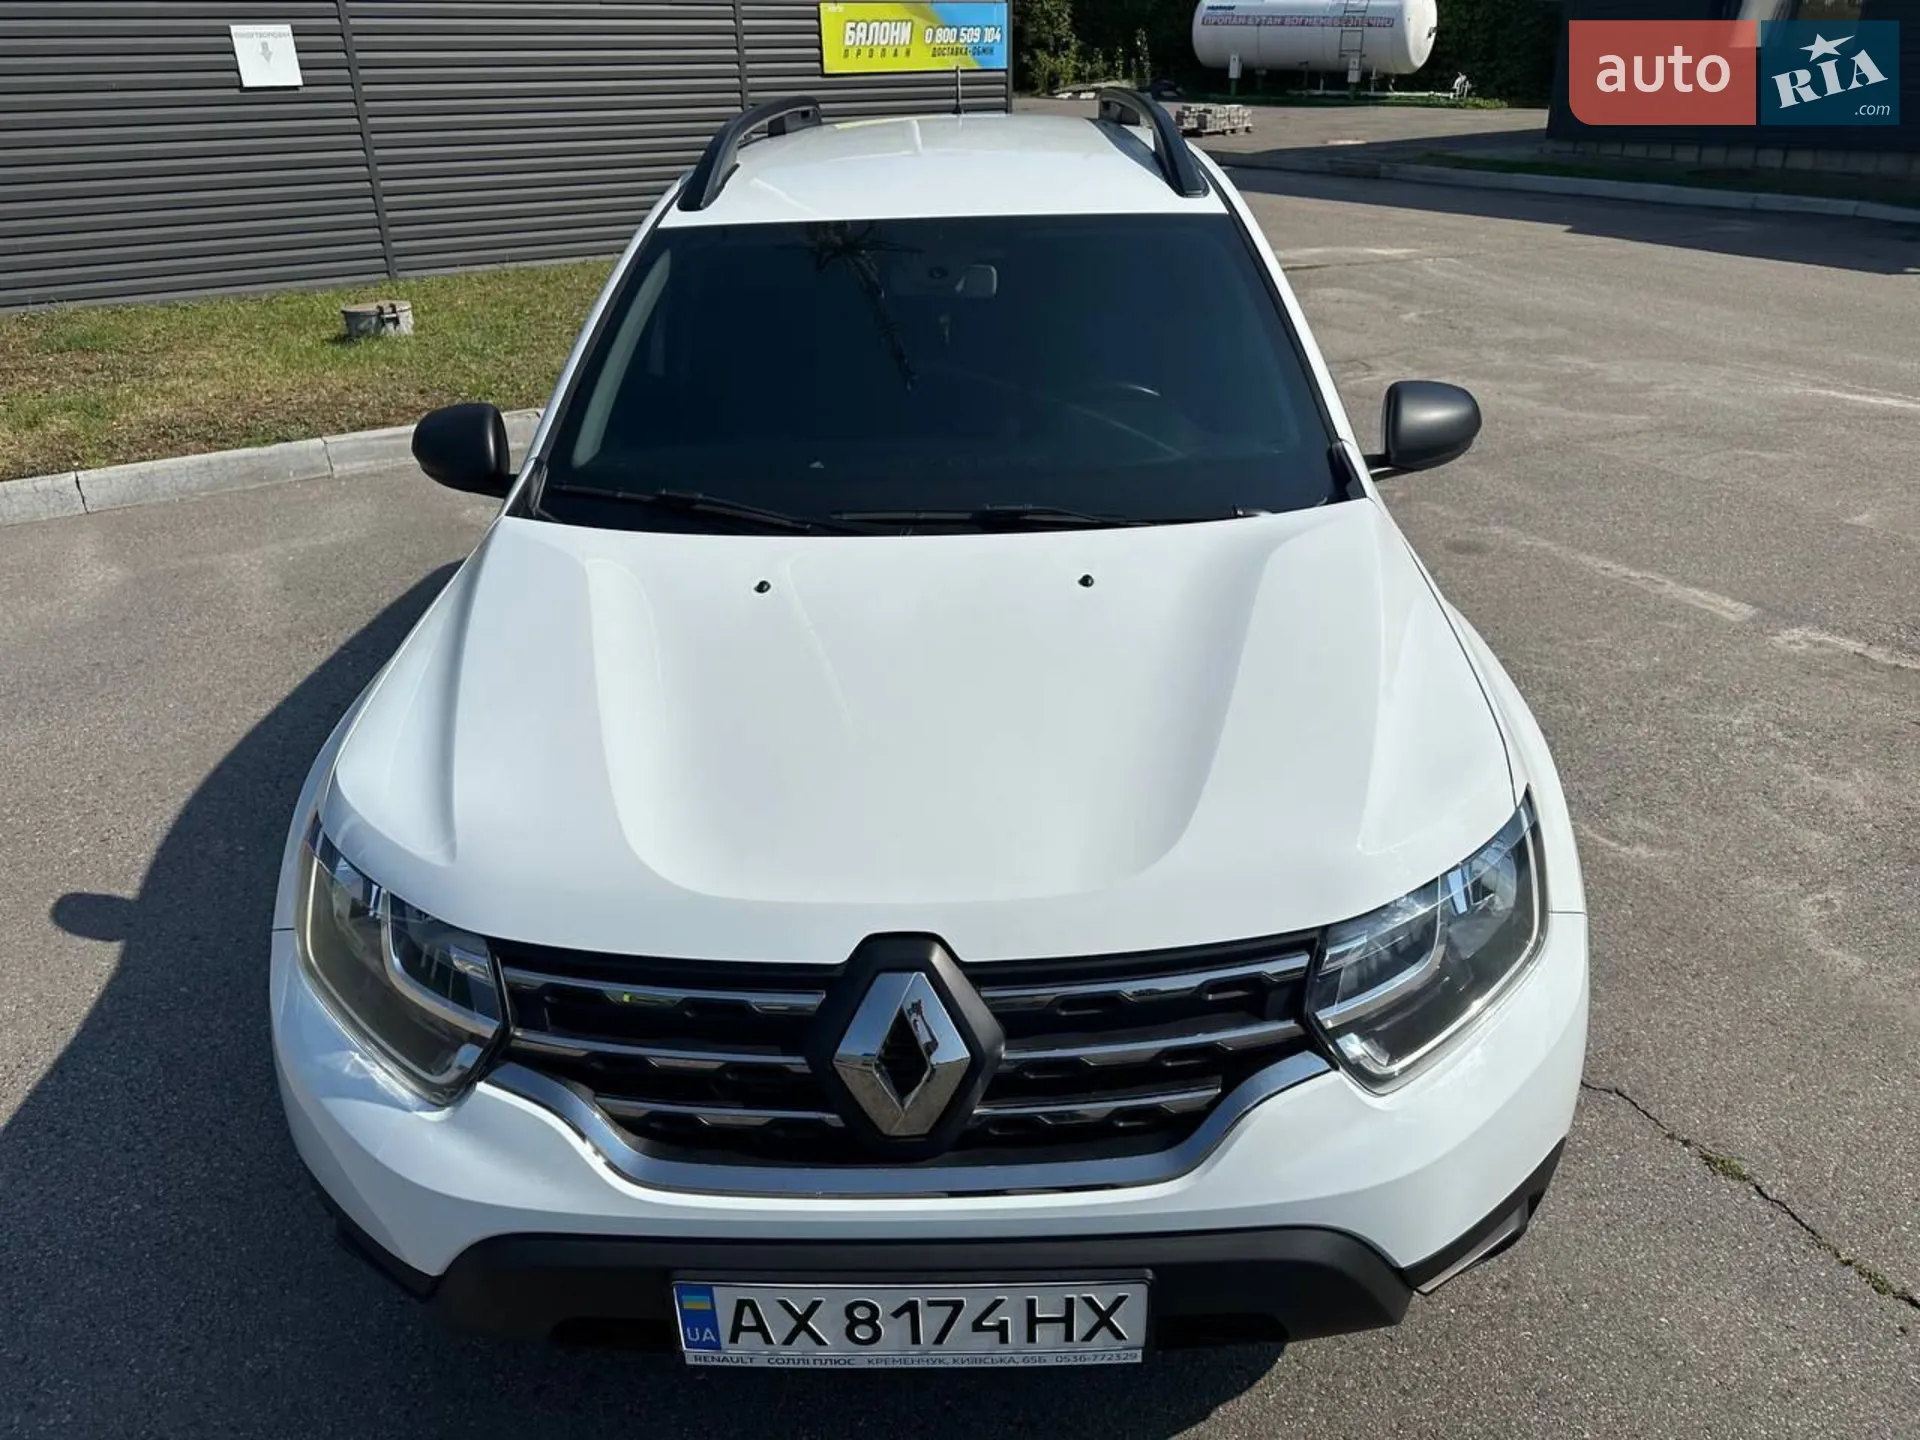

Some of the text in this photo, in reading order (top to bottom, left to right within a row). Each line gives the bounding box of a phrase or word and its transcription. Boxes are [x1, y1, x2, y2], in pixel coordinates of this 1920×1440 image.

[844, 22, 912, 46] БАЛОНИ
[924, 26, 1001, 44] 0 800 509 104
[843, 47, 911, 59] ПРОПАН
[728, 1294, 1129, 1346] AX 8174 HX
[686, 1328, 716, 1343] UA
[693, 1355, 755, 1365] RENAULT
[812, 1357, 856, 1366] ПЛЮС
